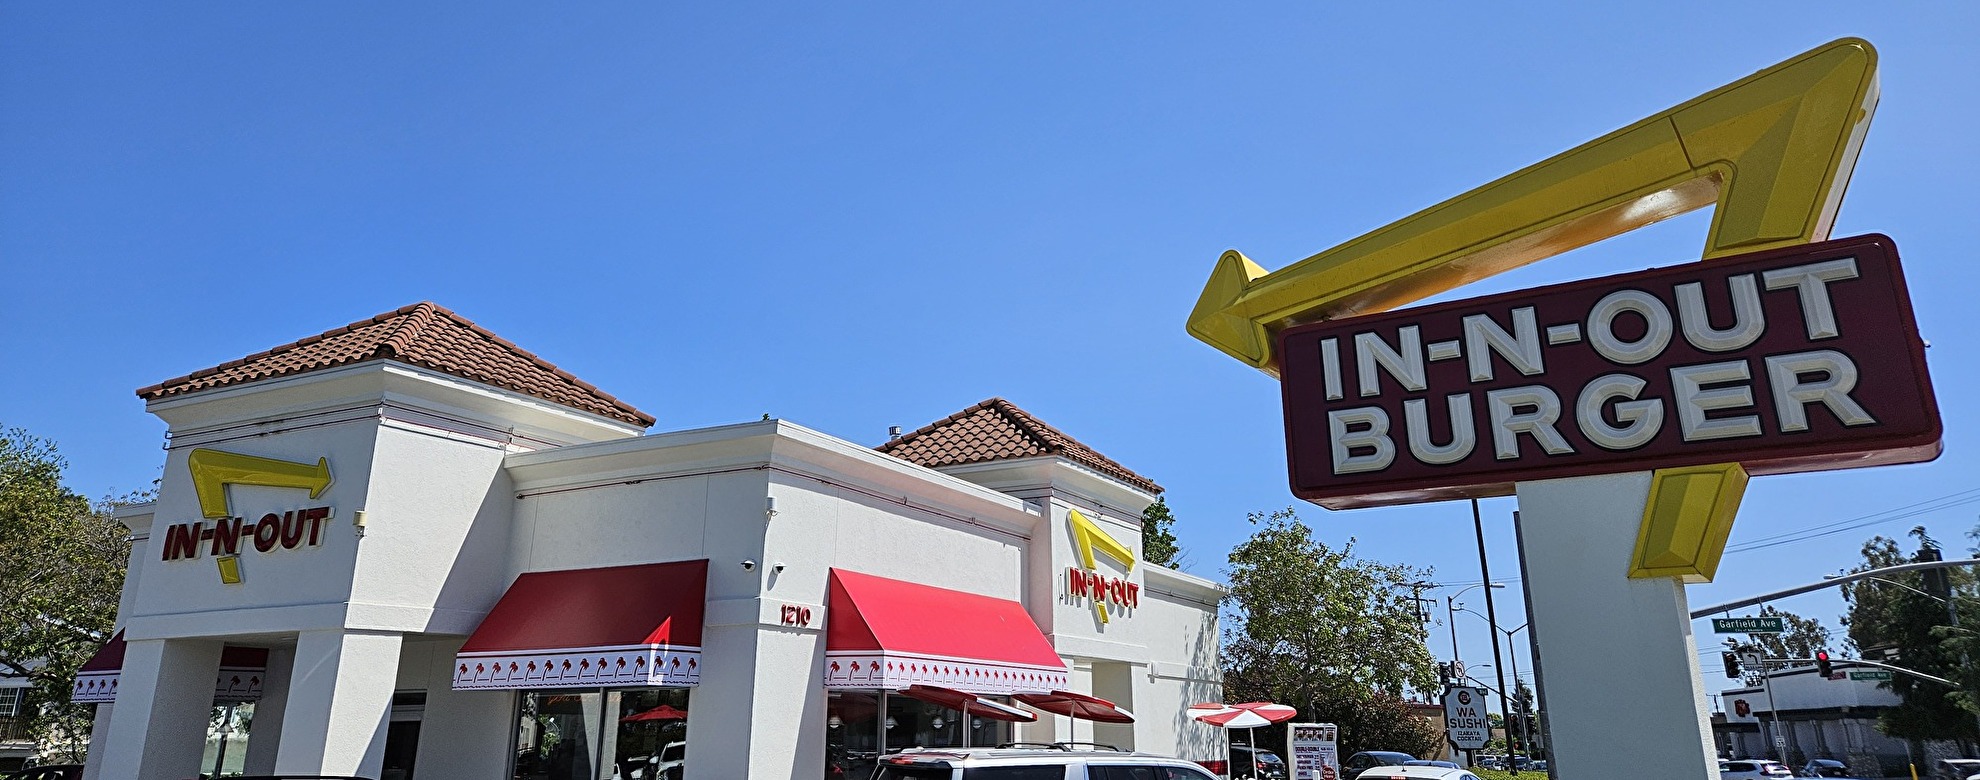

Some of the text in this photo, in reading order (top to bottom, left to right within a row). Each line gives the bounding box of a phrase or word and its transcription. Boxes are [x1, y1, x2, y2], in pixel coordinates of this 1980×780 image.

[1320, 256, 1860, 402] IN-N-OUT
[1326, 349, 1878, 476] BURGER
[162, 506, 331, 561] IN-N-OUT
[1069, 566, 1139, 610] IN-N-OUT
[781, 604, 811, 626] 1210
[1719, 619, 1776, 629] Garfield Ave
[1449, 718, 1487, 729] SUSHI
[1456, 707, 1477, 717] WA
